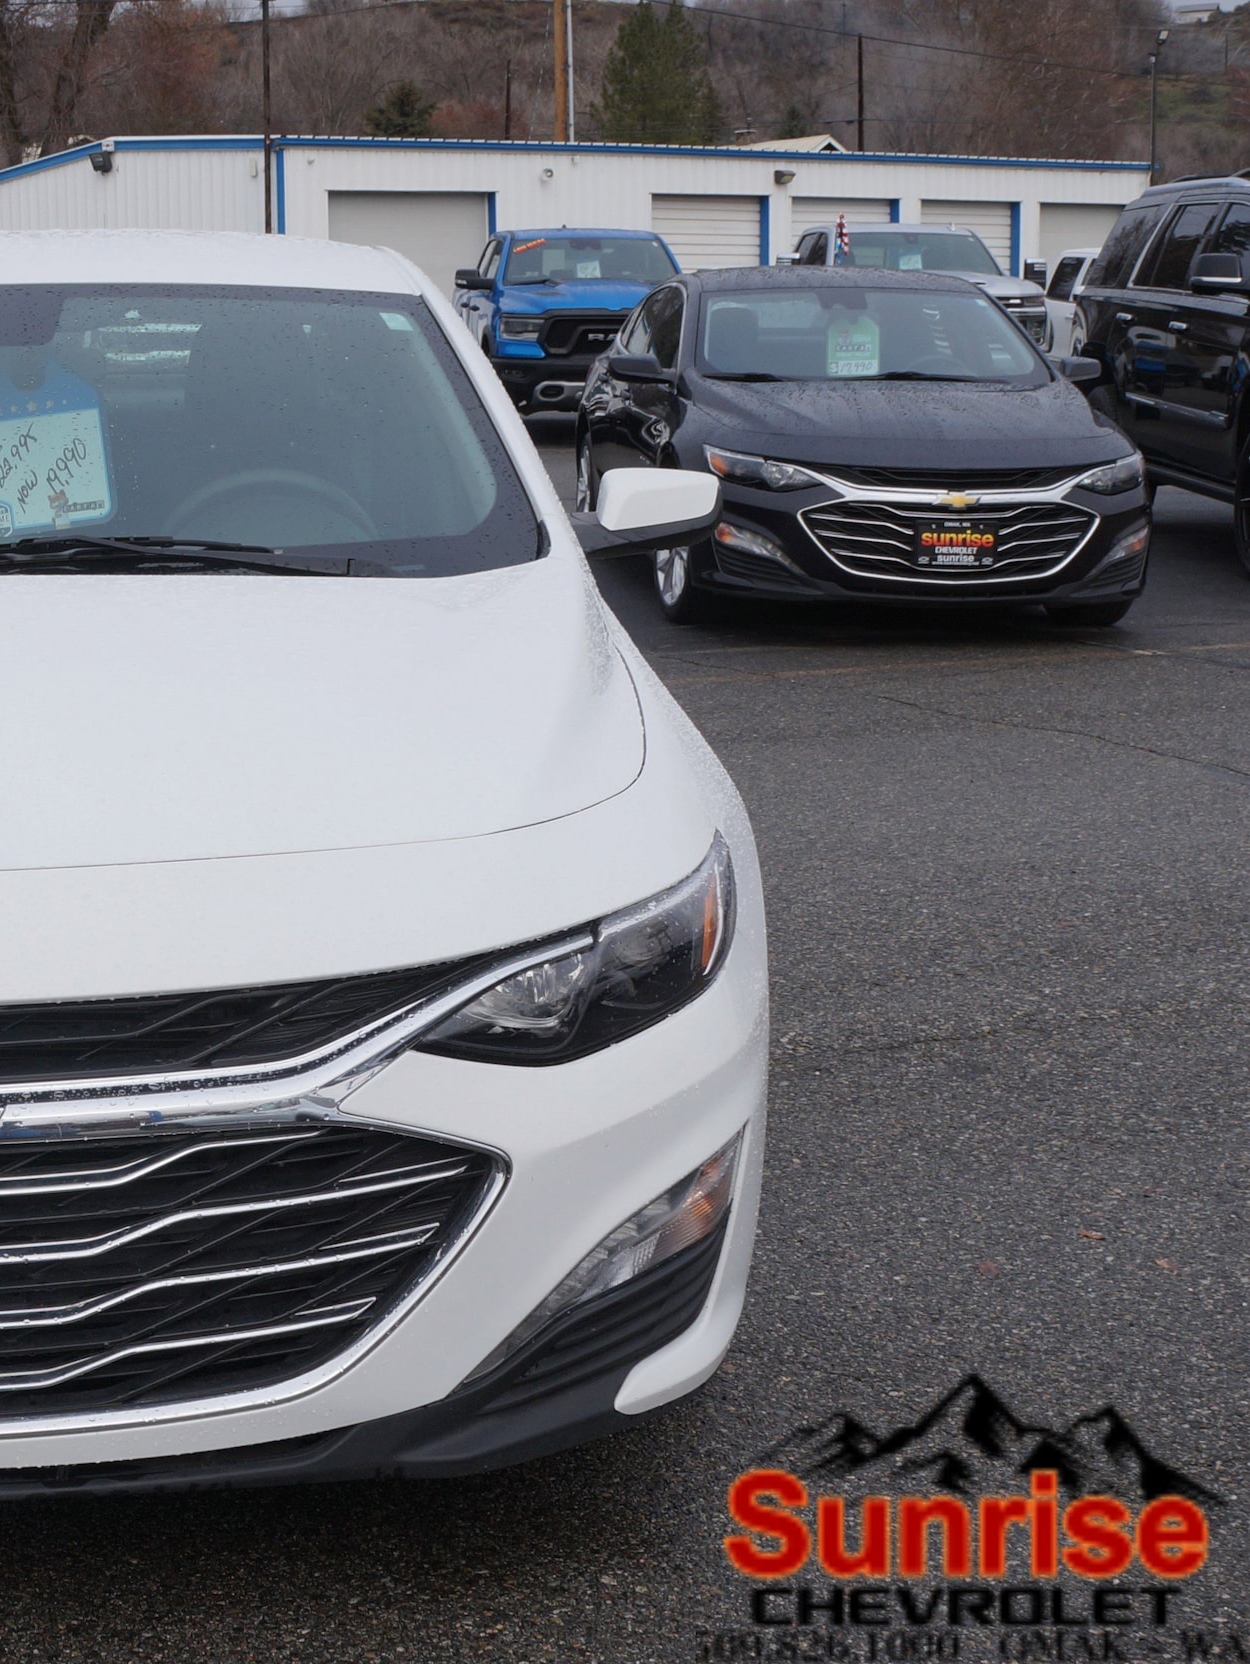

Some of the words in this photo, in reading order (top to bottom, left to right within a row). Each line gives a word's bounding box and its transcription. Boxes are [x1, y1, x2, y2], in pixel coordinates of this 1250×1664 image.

[588, 333, 617, 341] RA
[46, 437, 87, 495] 19,990
[16, 469, 38, 515] NOW
[921, 529, 994, 547] sunrise
[935, 546, 978, 554] CHEVROLET
[937, 553, 974, 562] sunrise
